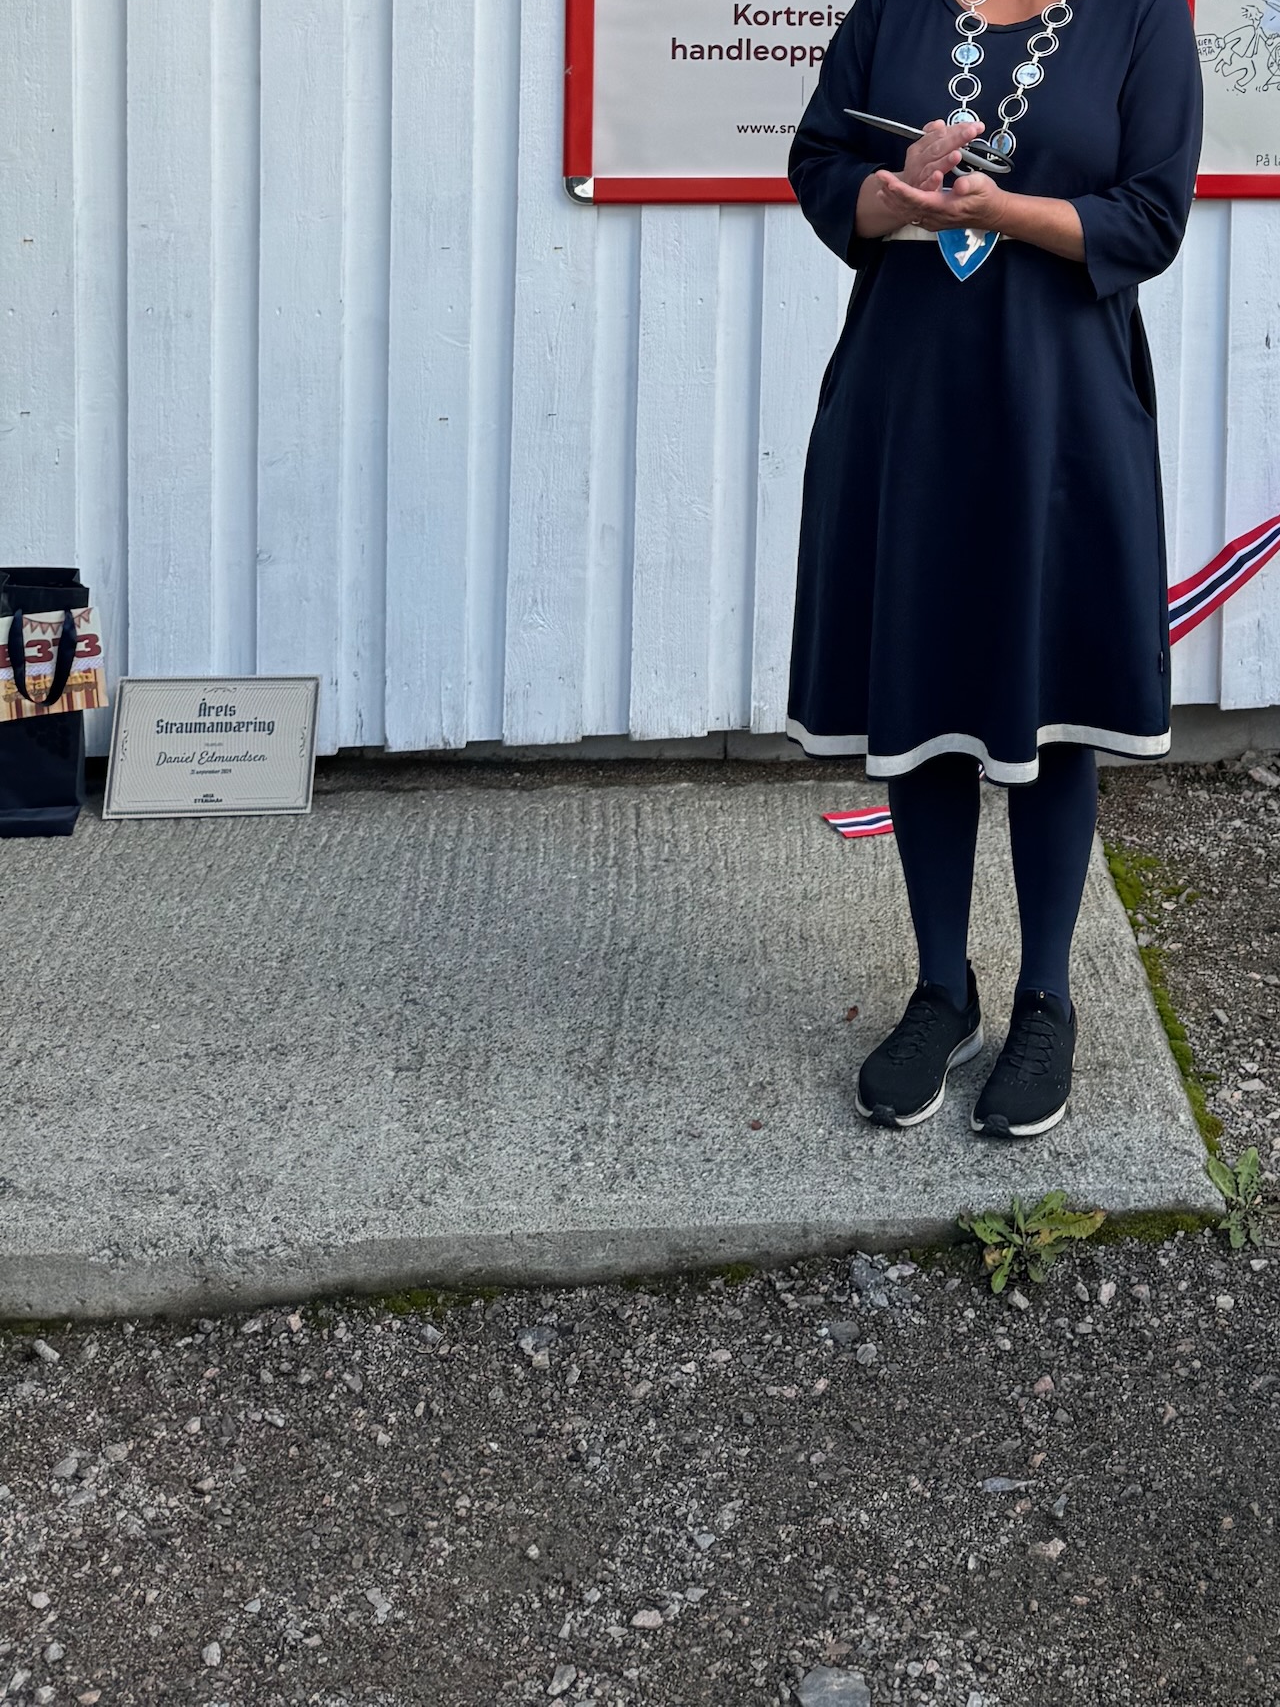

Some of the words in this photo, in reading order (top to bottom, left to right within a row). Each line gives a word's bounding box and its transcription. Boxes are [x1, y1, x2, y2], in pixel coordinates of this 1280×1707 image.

[1256, 154, 1270, 167] På
[198, 698, 237, 718] Årets
[156, 751, 197, 766] Daniel
[197, 750, 268, 766] Edmundsen
